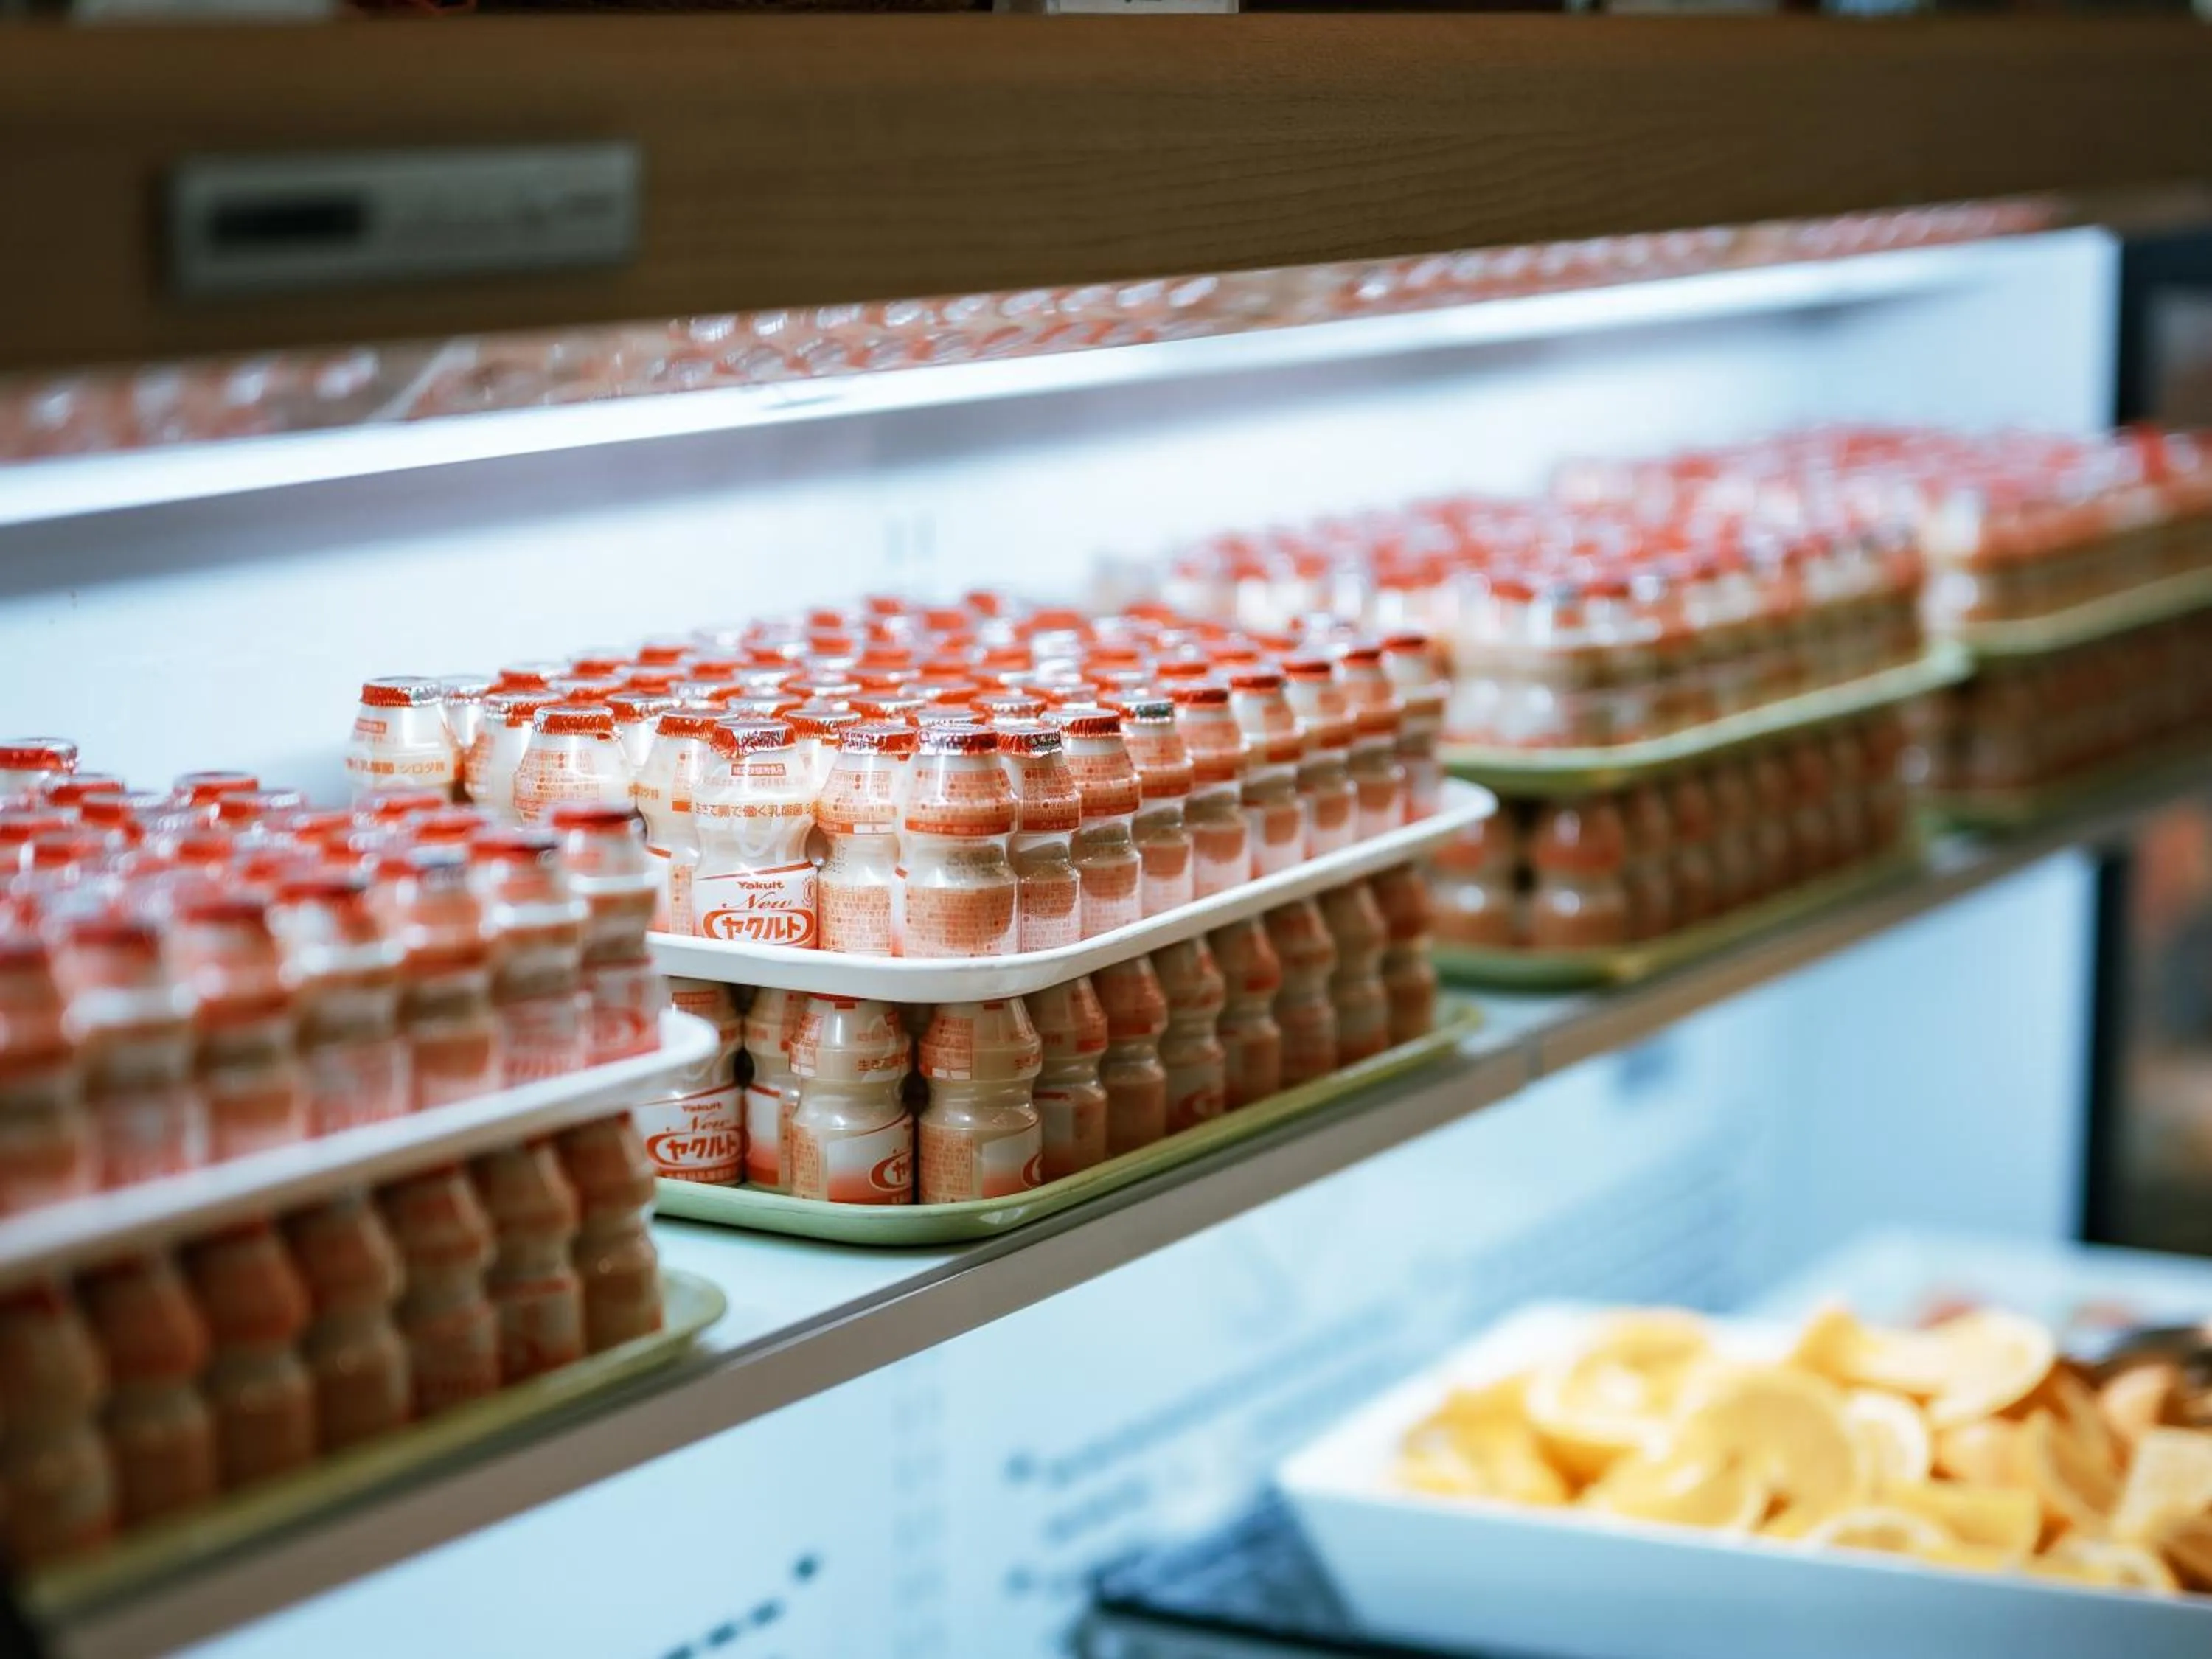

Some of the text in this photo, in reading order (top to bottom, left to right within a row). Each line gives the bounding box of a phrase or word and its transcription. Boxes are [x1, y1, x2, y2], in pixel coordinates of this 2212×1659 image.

[737, 880, 785, 890] Yakult
[721, 917, 801, 940] ヤクルト
[666, 1134, 737, 1161] ヤクルト
